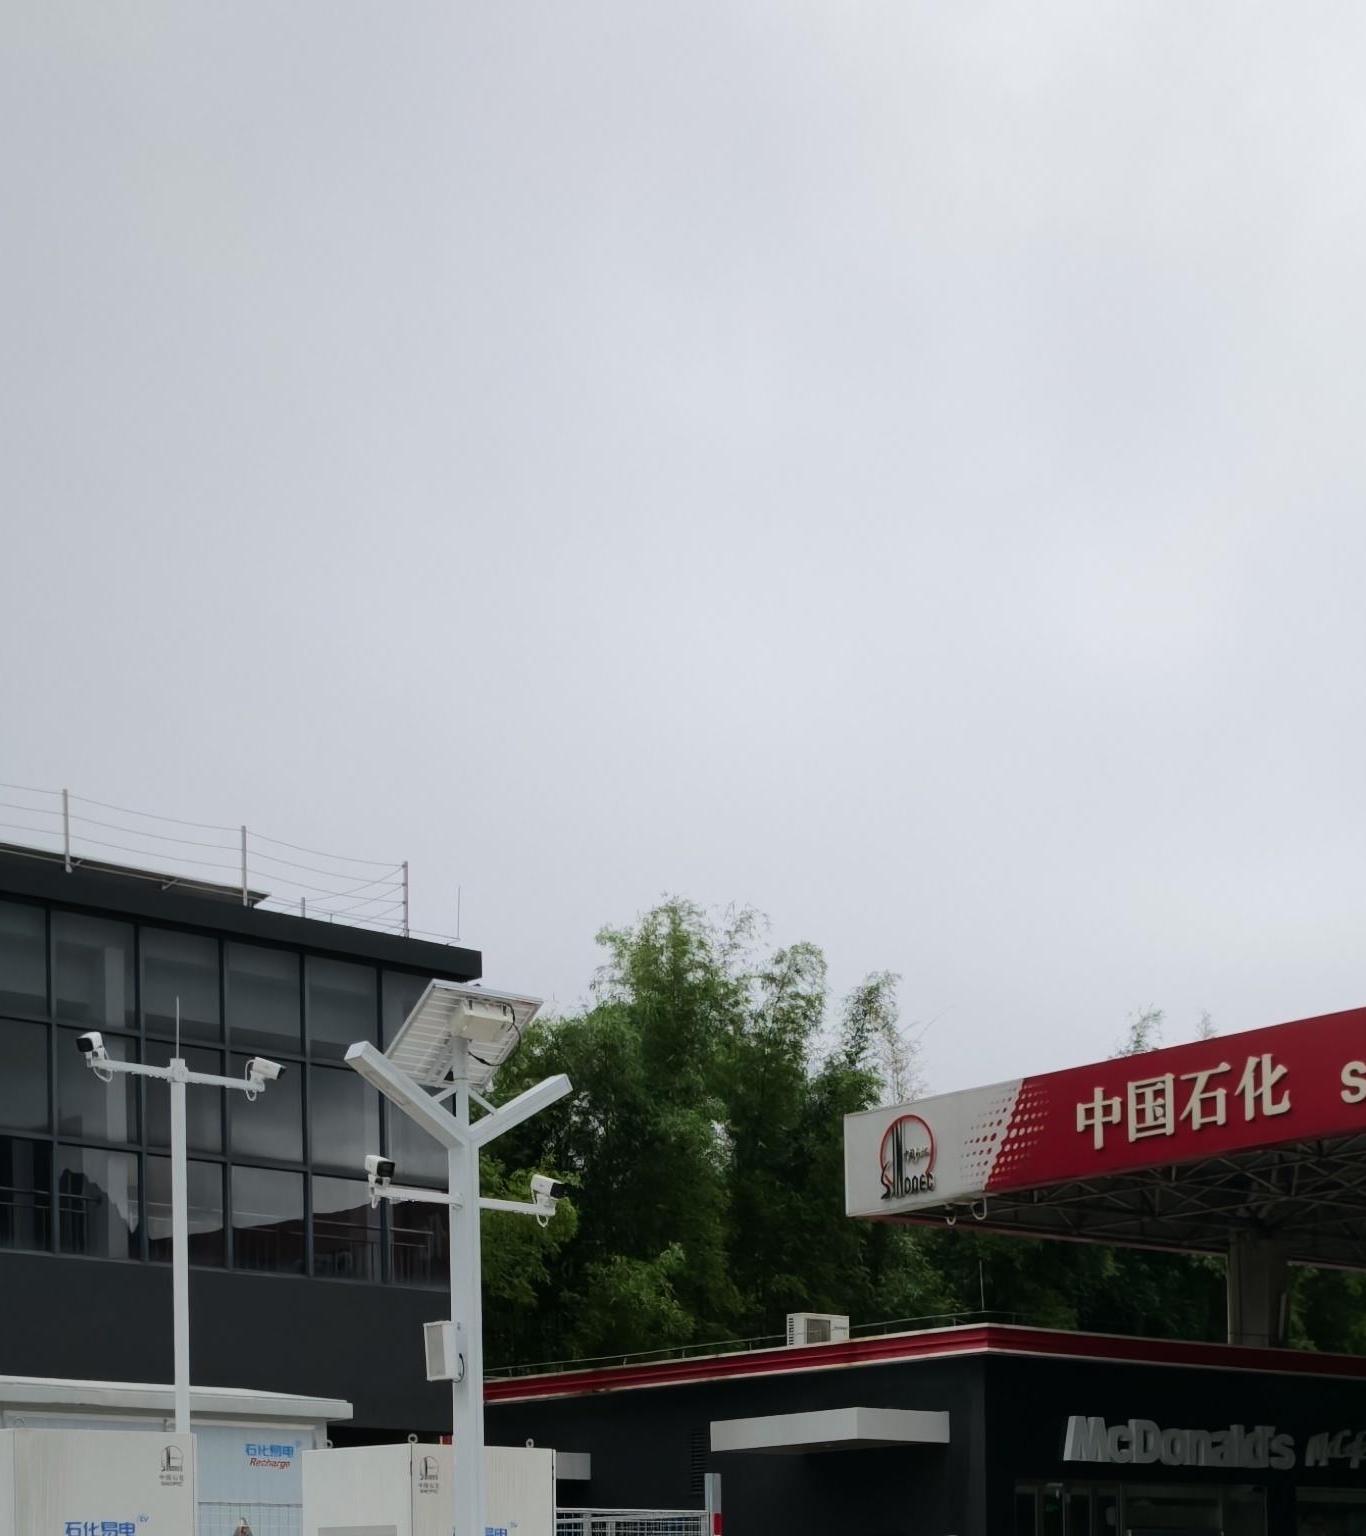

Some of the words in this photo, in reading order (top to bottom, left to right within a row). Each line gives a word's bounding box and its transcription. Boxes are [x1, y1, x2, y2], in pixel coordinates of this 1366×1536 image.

[1076, 1053, 1292, 1151] 中国石化
[1063, 1415, 1296, 1470] McDonald's
